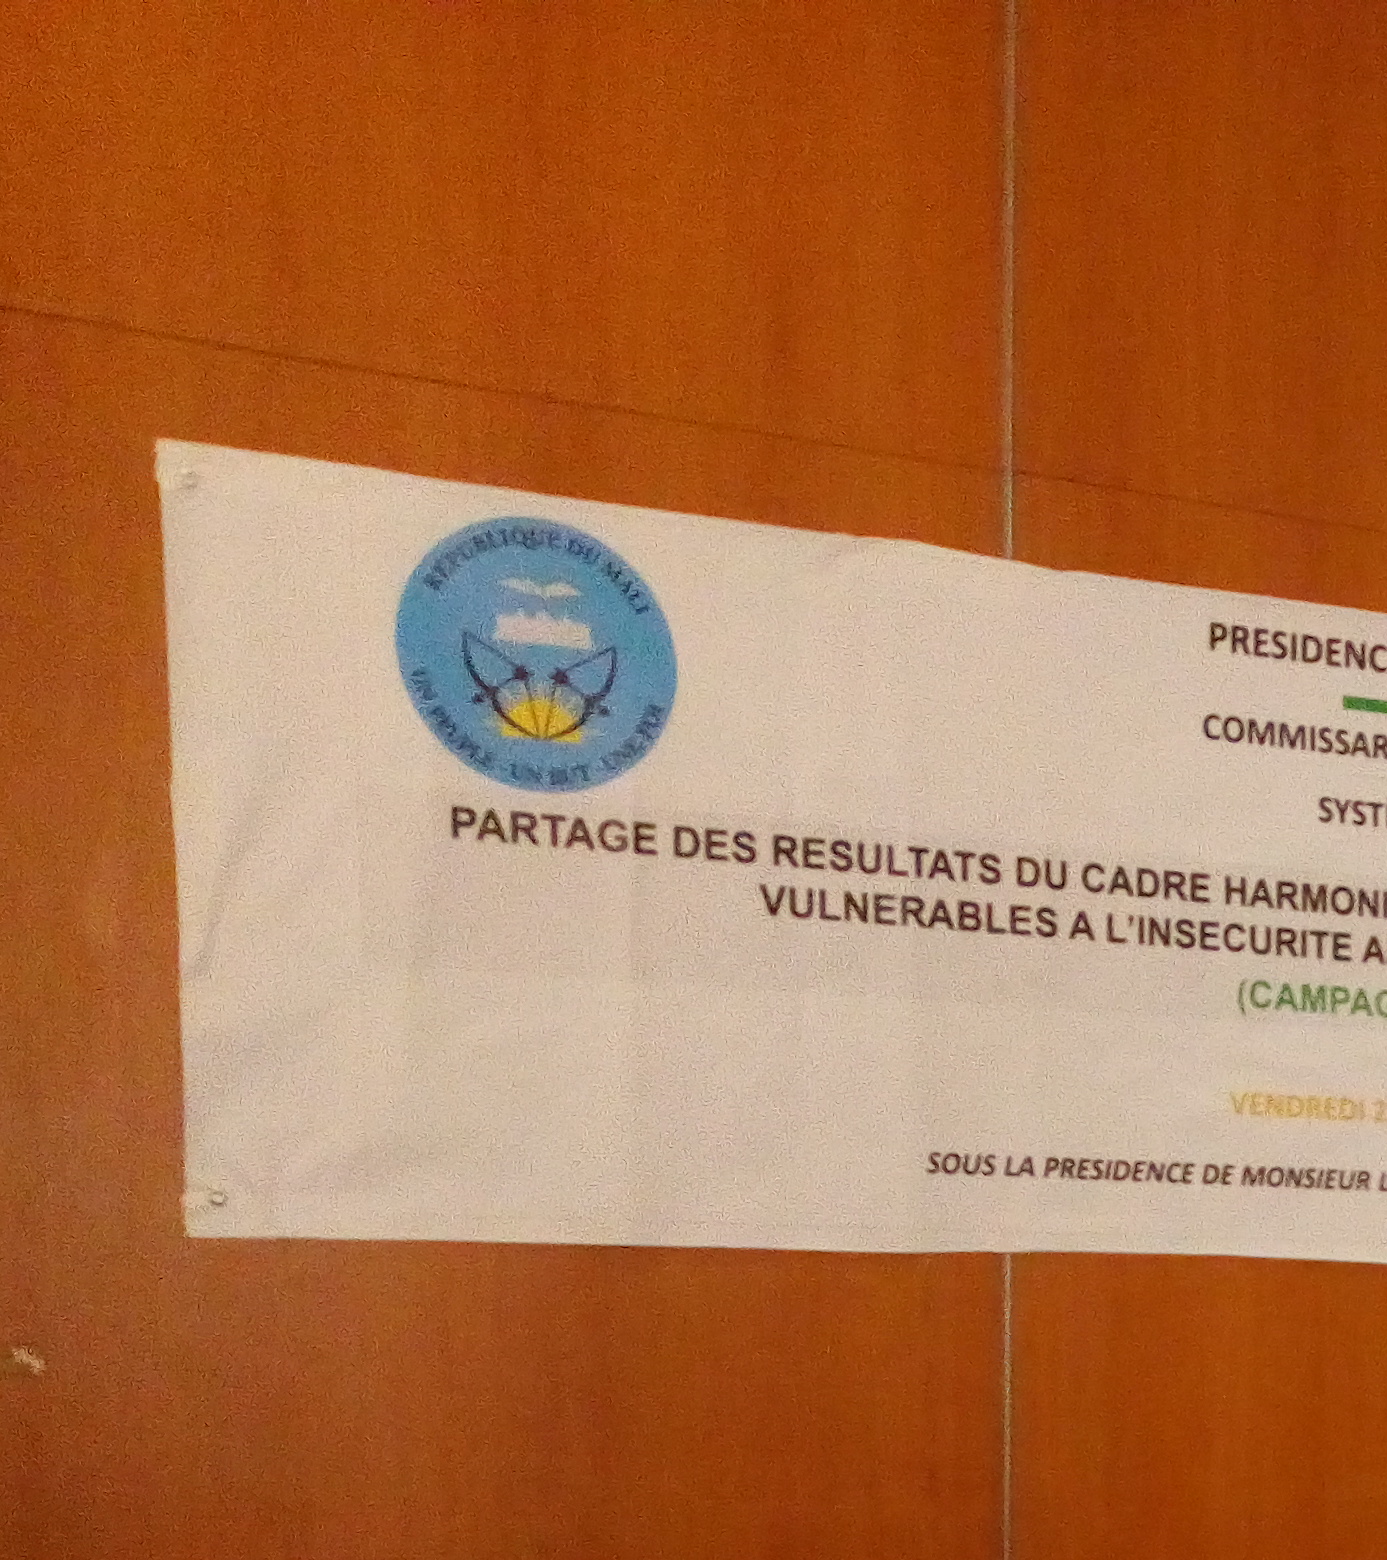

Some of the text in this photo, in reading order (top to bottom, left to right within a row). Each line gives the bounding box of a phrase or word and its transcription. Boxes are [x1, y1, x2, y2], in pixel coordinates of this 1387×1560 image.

[602, 561, 650, 615] MALI
[451, 806, 658, 856] PARTAGE
[673, 826, 757, 864] DES
[772, 834, 1001, 885] RESULTATS
[1016, 856, 1067, 890] DU
[1081, 862, 1211, 904] CADRE
[760, 883, 1058, 938] VULNERABLES
[1069, 911, 1095, 941] A
[1105, 912, 1352, 962] L'INSECURITE
[1230, 1091, 1365, 1122] VENDREDI
[925, 1152, 996, 1177] SOUS
[1003, 1155, 1035, 1178] LA
[1043, 1156, 1195, 1185] PRESIDENCE
[1202, 1163, 1236, 1186] DE
[1240, 1165, 1371, 1191] MONSIEUR
